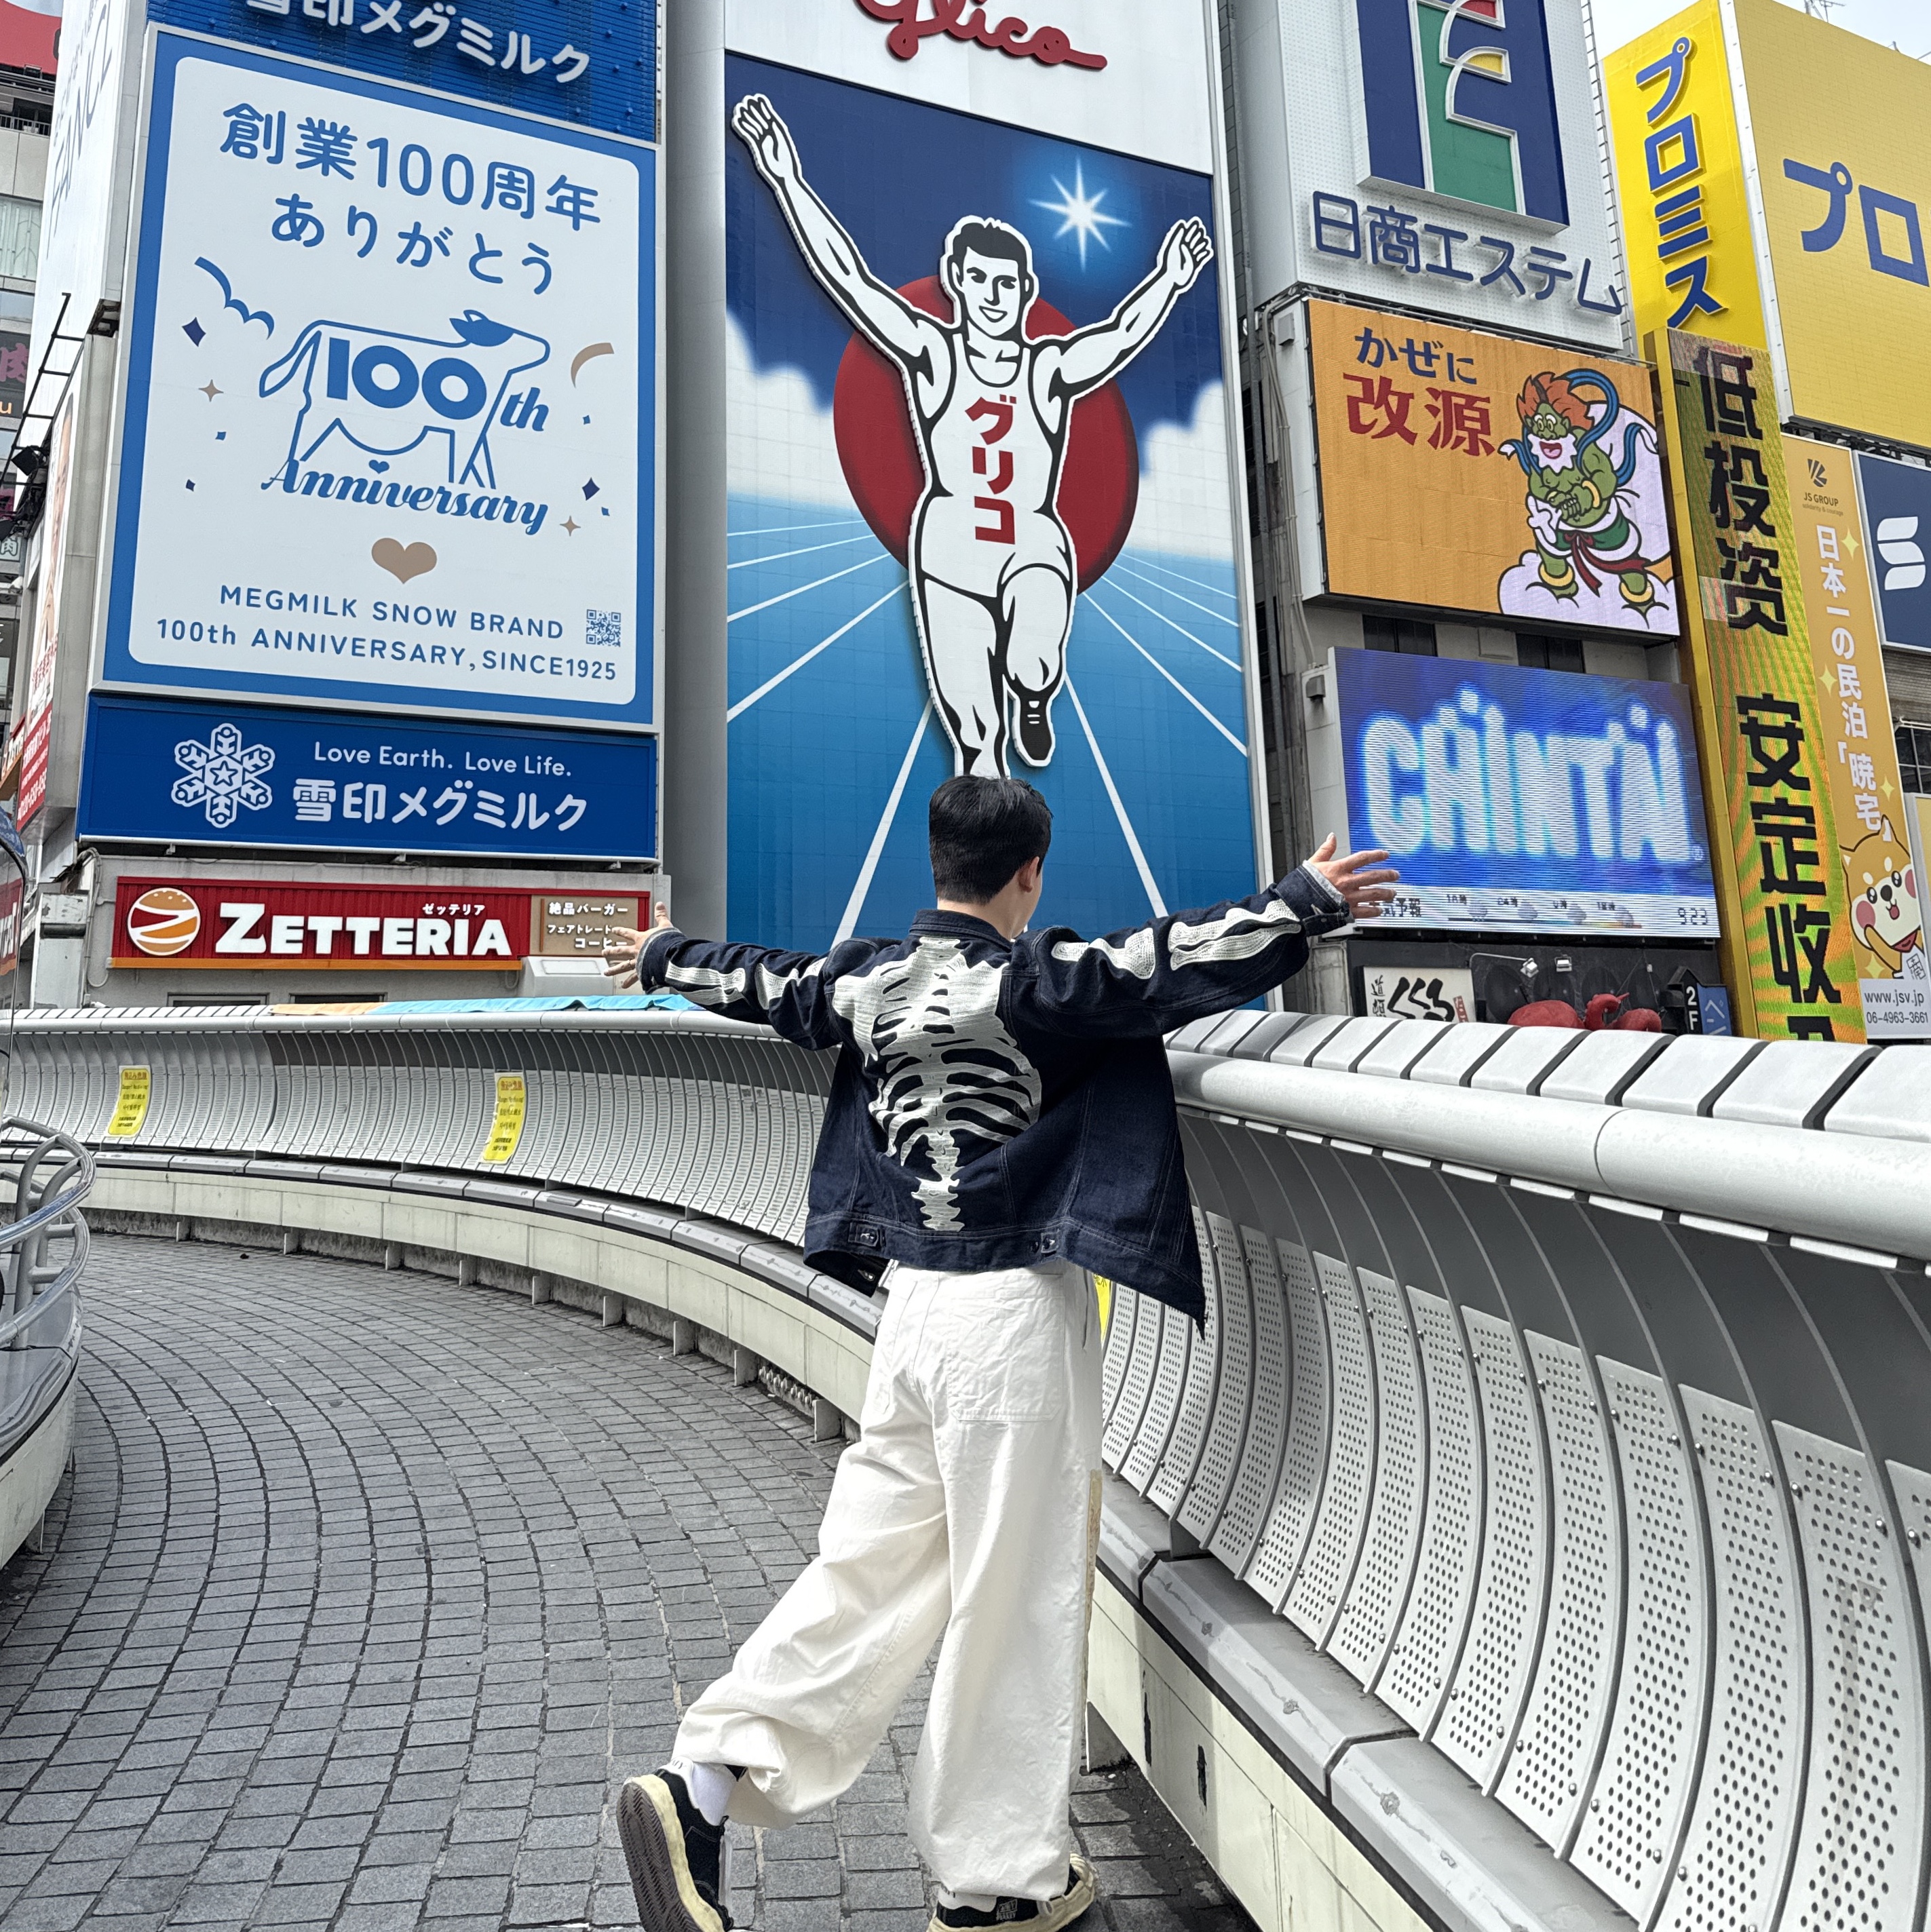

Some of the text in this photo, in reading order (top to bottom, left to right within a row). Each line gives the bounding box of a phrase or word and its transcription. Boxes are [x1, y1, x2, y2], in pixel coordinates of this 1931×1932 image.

[246, 0, 590, 83] 印メグミルク
[219, 102, 600, 231] 創業100周年
[1635, 36, 1729, 330] プロミス
[271, 193, 553, 295] ありがとう
[1782, 159, 1930, 287] プロ
[1312, 191, 1622, 316] 日商エステム
[1355, 327, 1477, 385] かぜに
[327, 338, 549, 431] 100th
[1343, 372, 1495, 457] 改源
[261, 459, 548, 535] Anniversary
[964, 394, 1016, 545] グリコ
[1693, 346, 1789, 637] 低投資
[1804, 492, 1839, 506] JS GROUP
[156, 619, 237, 646] 100th
[221, 585, 564, 640] MEGMILK SNOW BRAND
[314, 741, 573, 777] Love Earth. Love Life.
[292, 778, 588, 832] 雪印メグミルク
[215, 902, 513, 956] ZETTERIA
[422, 903, 485, 915] ゼッテリア
[548, 902, 628, 916] 絶品バーガー
[575, 937, 628, 949] コーヒー
[1686, 986, 1698, 1030] 2F
[1865, 989, 1924, 1007] www.jsv.jp
[1867, 1011, 1928, 1024] 06-4963-3661
